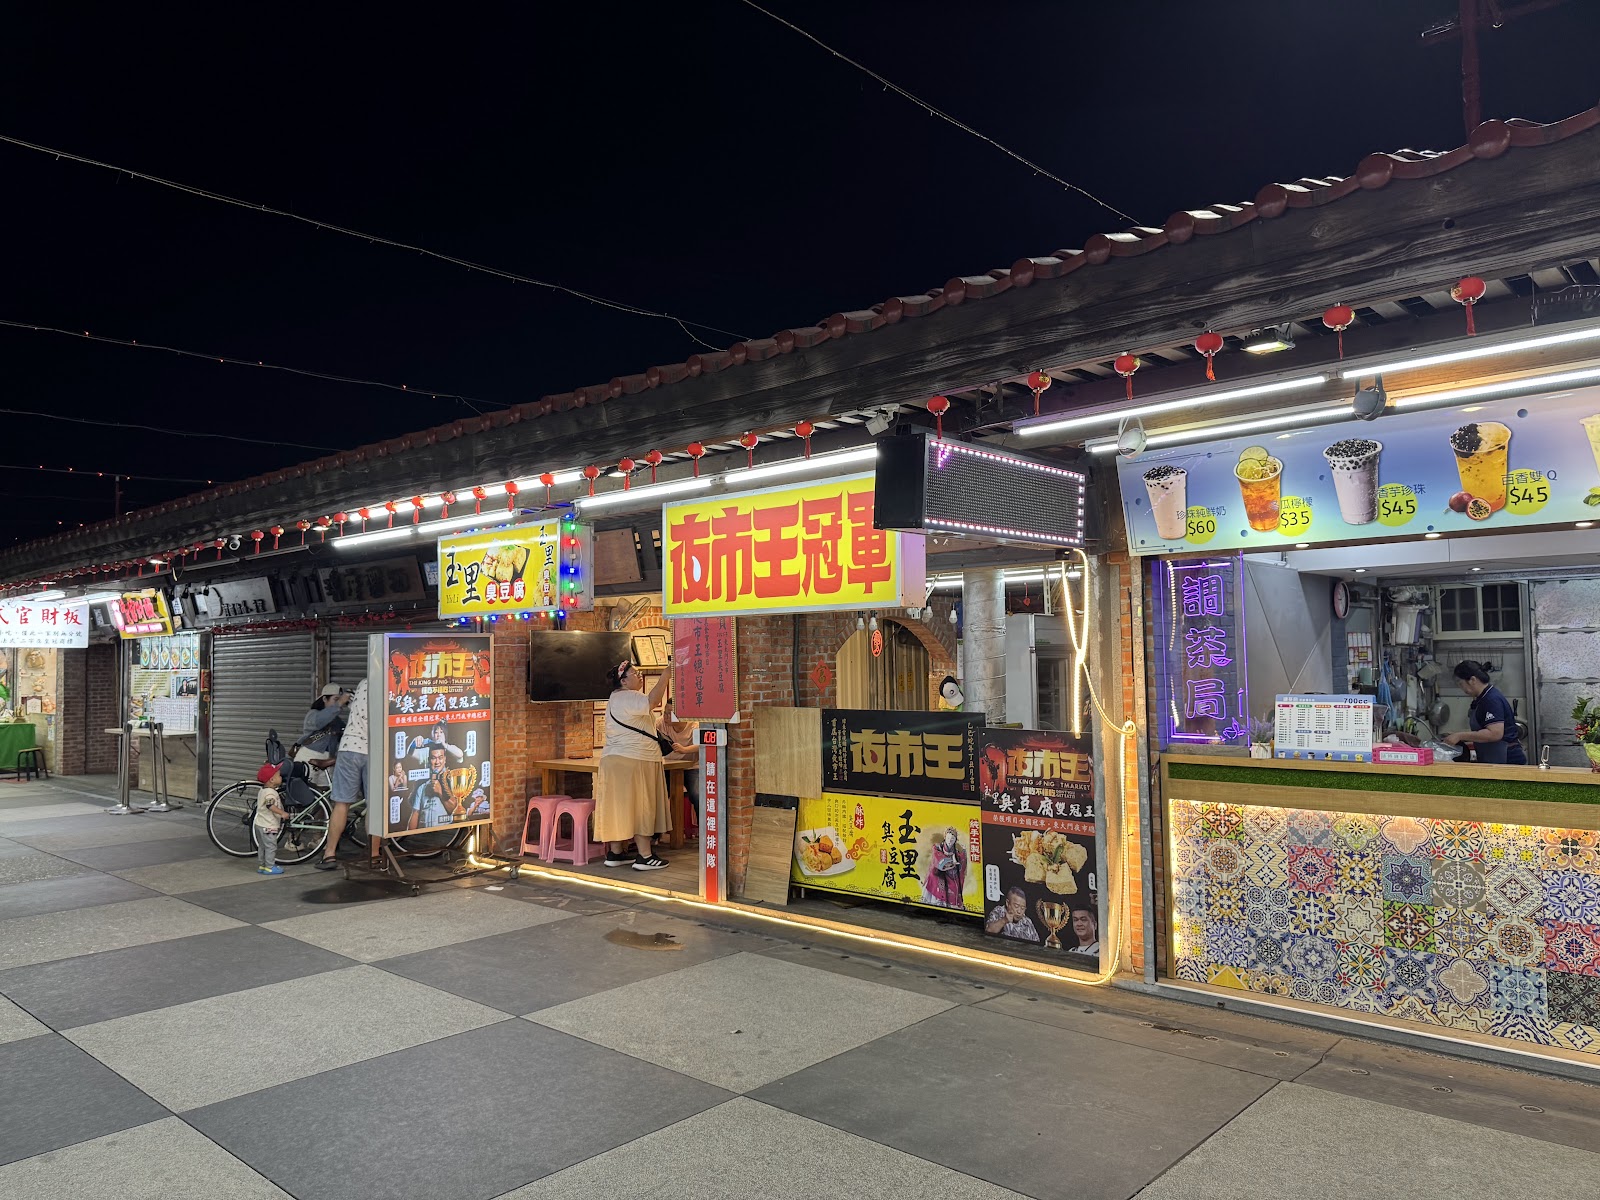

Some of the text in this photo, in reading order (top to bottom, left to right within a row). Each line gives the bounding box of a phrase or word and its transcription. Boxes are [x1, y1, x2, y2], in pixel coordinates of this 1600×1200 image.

[1377, 483, 1426, 499] 香芋珍珠
[1382, 499, 1416, 518] $45
[1510, 486, 1548, 506] $45
[1176, 505, 1227, 520] 珍珠純鮮奶
[1188, 520, 1216, 536] $60
[1280, 511, 1310, 528] $35
[540, 525, 555, 566] 玉里
[670, 490, 891, 605] 夜市王冠軍
[446, 546, 481, 605] 玉里
[486, 581, 524, 602] 臭豆腐
[410, 651, 474, 679] 夜市王
[1182, 575, 1229, 720] 調茶局
[850, 728, 965, 780] 夜市王
[1007, 748, 1091, 782] 夜市王
[706, 762, 716, 868] 請在這裡排隊
[881, 821, 899, 890] 臭豆腐
[899, 809, 921, 880] 玉里
[969, 819, 980, 863] 純手工製作
